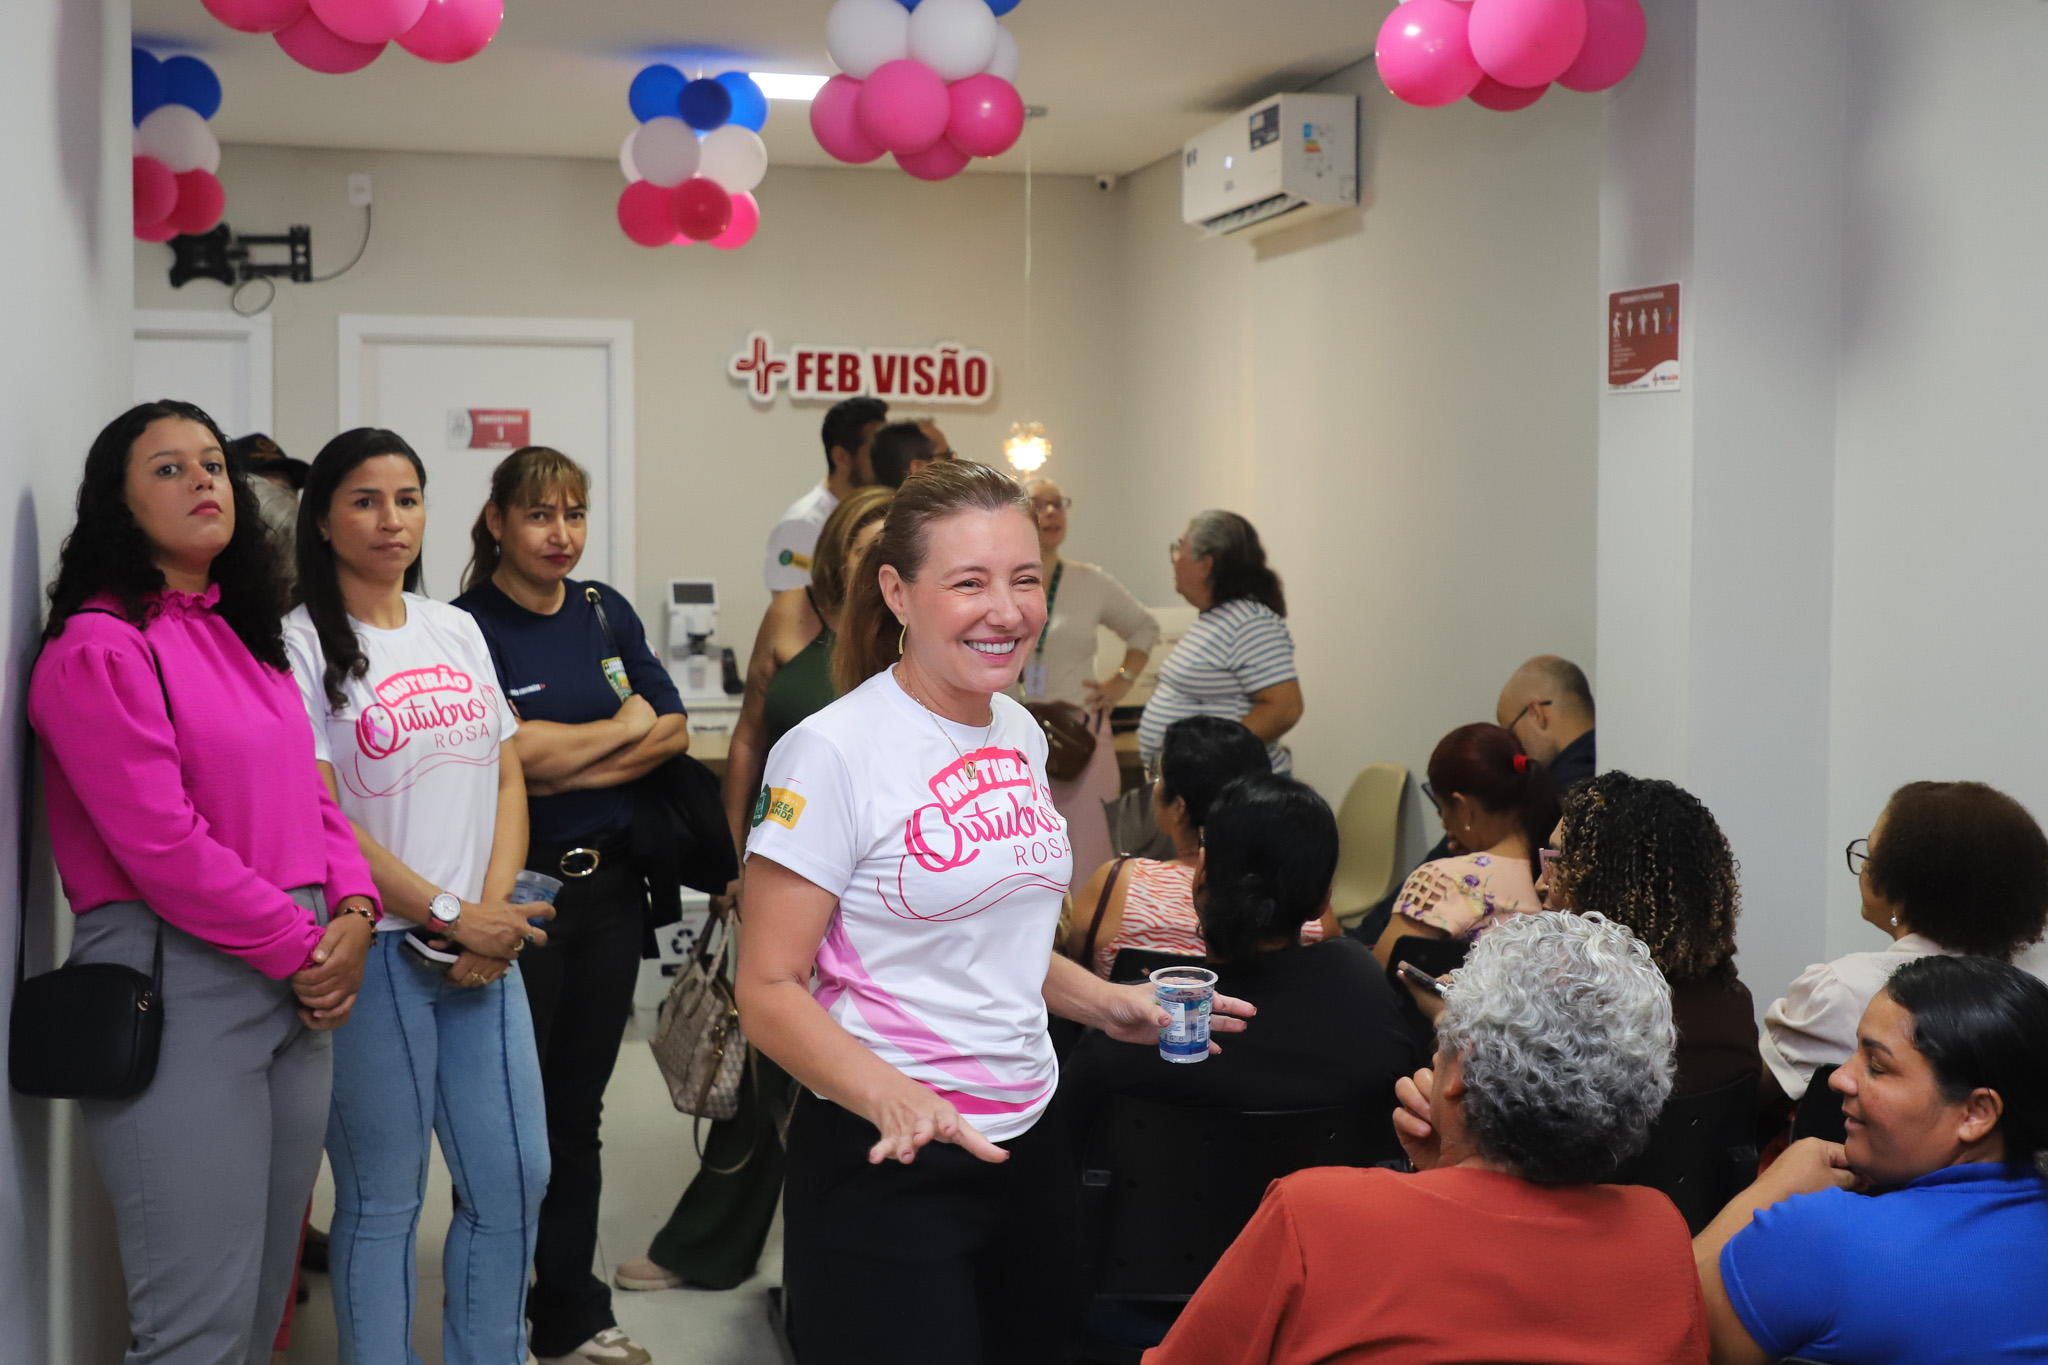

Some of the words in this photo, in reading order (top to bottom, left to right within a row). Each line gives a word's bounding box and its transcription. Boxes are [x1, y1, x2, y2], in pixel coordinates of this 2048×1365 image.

[797, 352, 861, 392] FEB
[872, 347, 987, 397] VISÃO
[378, 666, 470, 704] MUTIRÃO
[356, 696, 487, 760] Outubro
[434, 723, 491, 749] ROSA
[904, 792, 1062, 873] Outubro
[1013, 835, 1071, 867] ROSA
